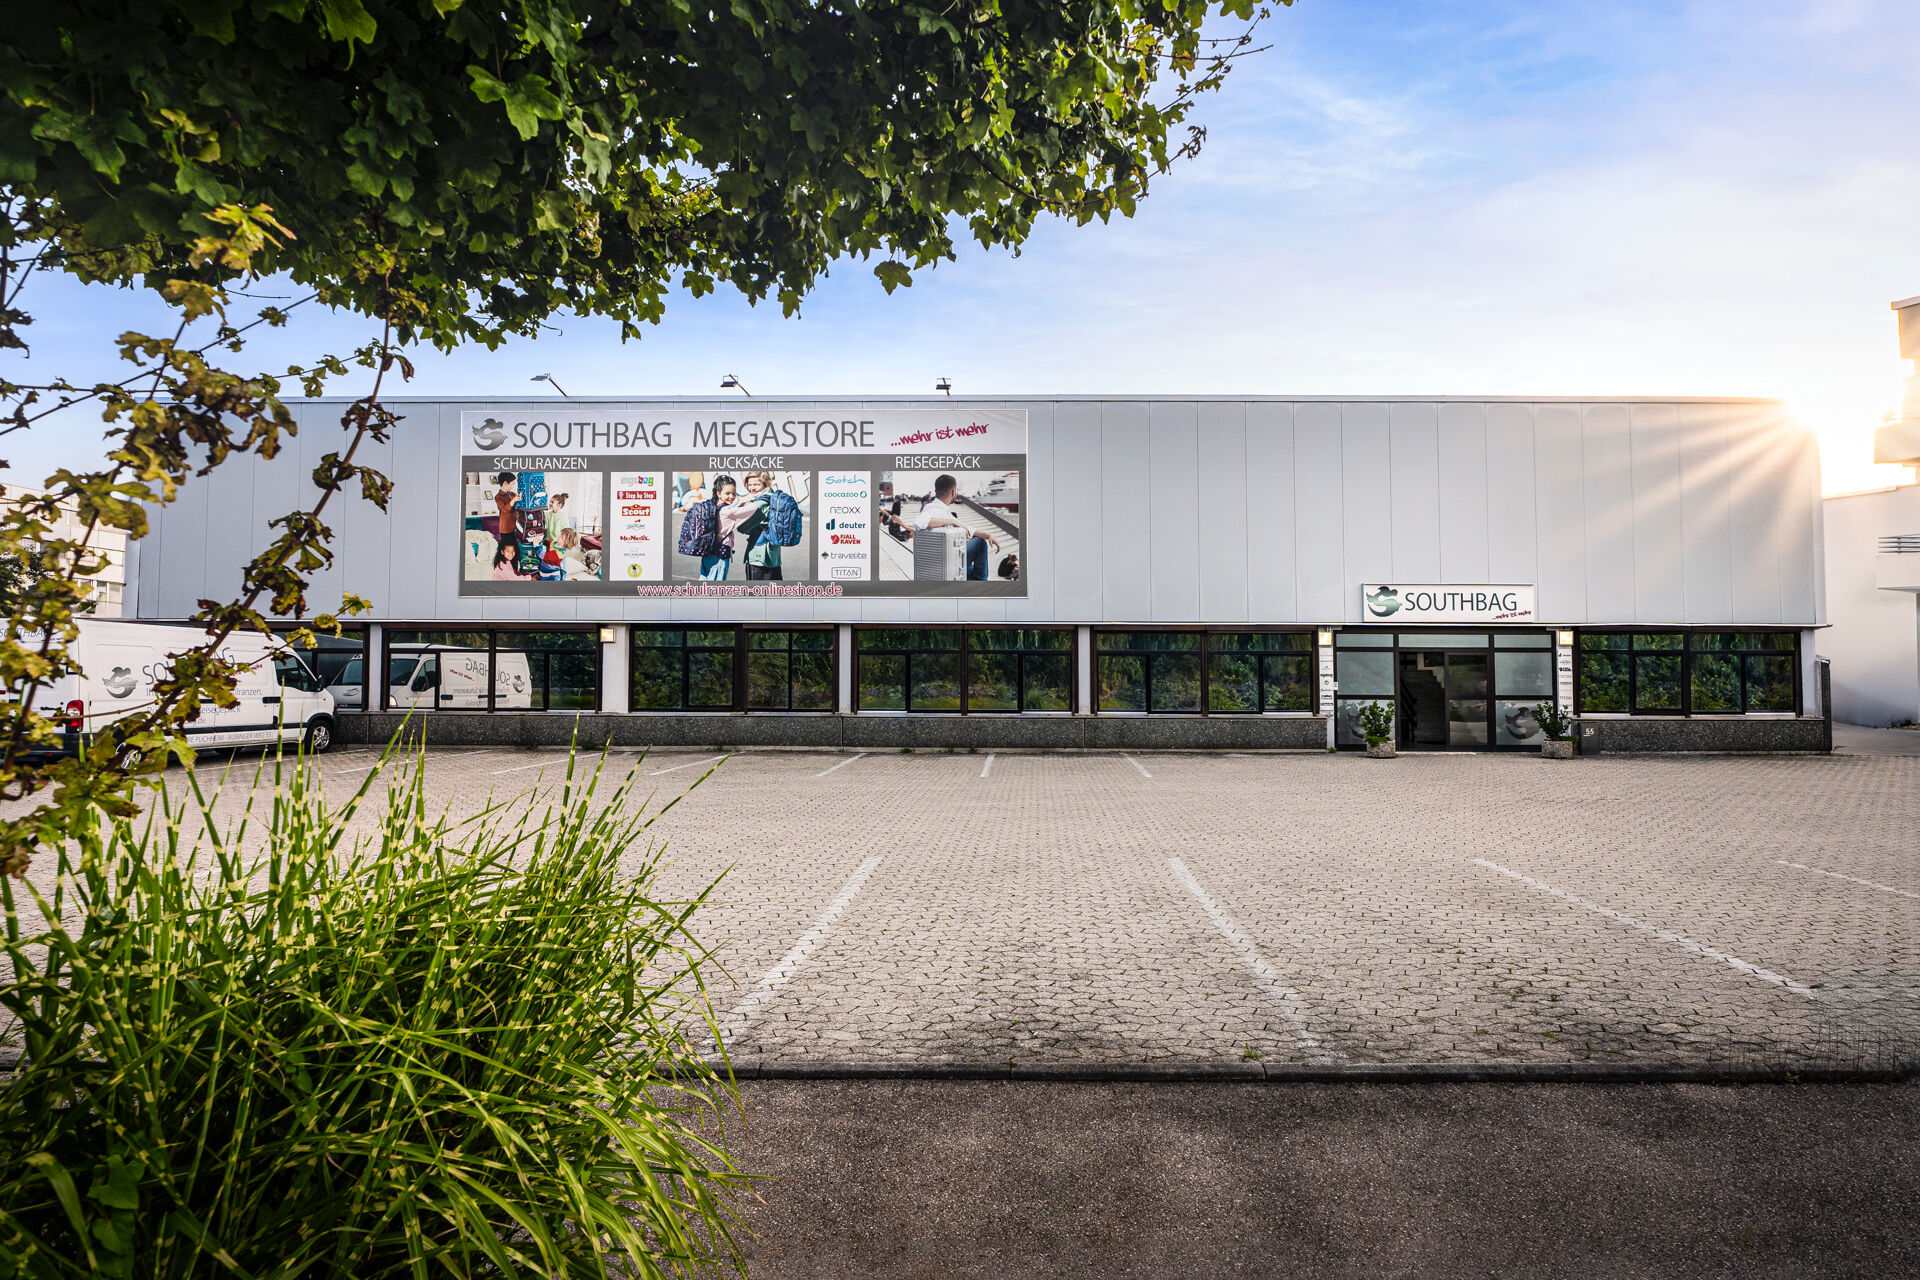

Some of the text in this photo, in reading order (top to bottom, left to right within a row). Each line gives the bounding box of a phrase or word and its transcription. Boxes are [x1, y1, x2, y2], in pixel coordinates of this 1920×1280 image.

[513, 420, 875, 449] SOUTHBAG MEGASTORE
[935, 425, 954, 440] ist
[955, 421, 990, 438] mehr
[493, 457, 588, 470] SCHULRANZEN
[708, 454, 784, 469] RUCKSÄCKE
[895, 454, 981, 469] REISEGEPÄCK
[620, 475, 654, 487] ergobag
[625, 491, 654, 500] Step by Step
[622, 507, 650, 516] Scout
[839, 521, 866, 529] deuter
[830, 551, 867, 560] travelite
[637, 582, 843, 597] www.schulranzen-onlineshop.de
[1405, 592, 1517, 611] SOUTHBAG
[1585, 727, 1595, 735] 55
